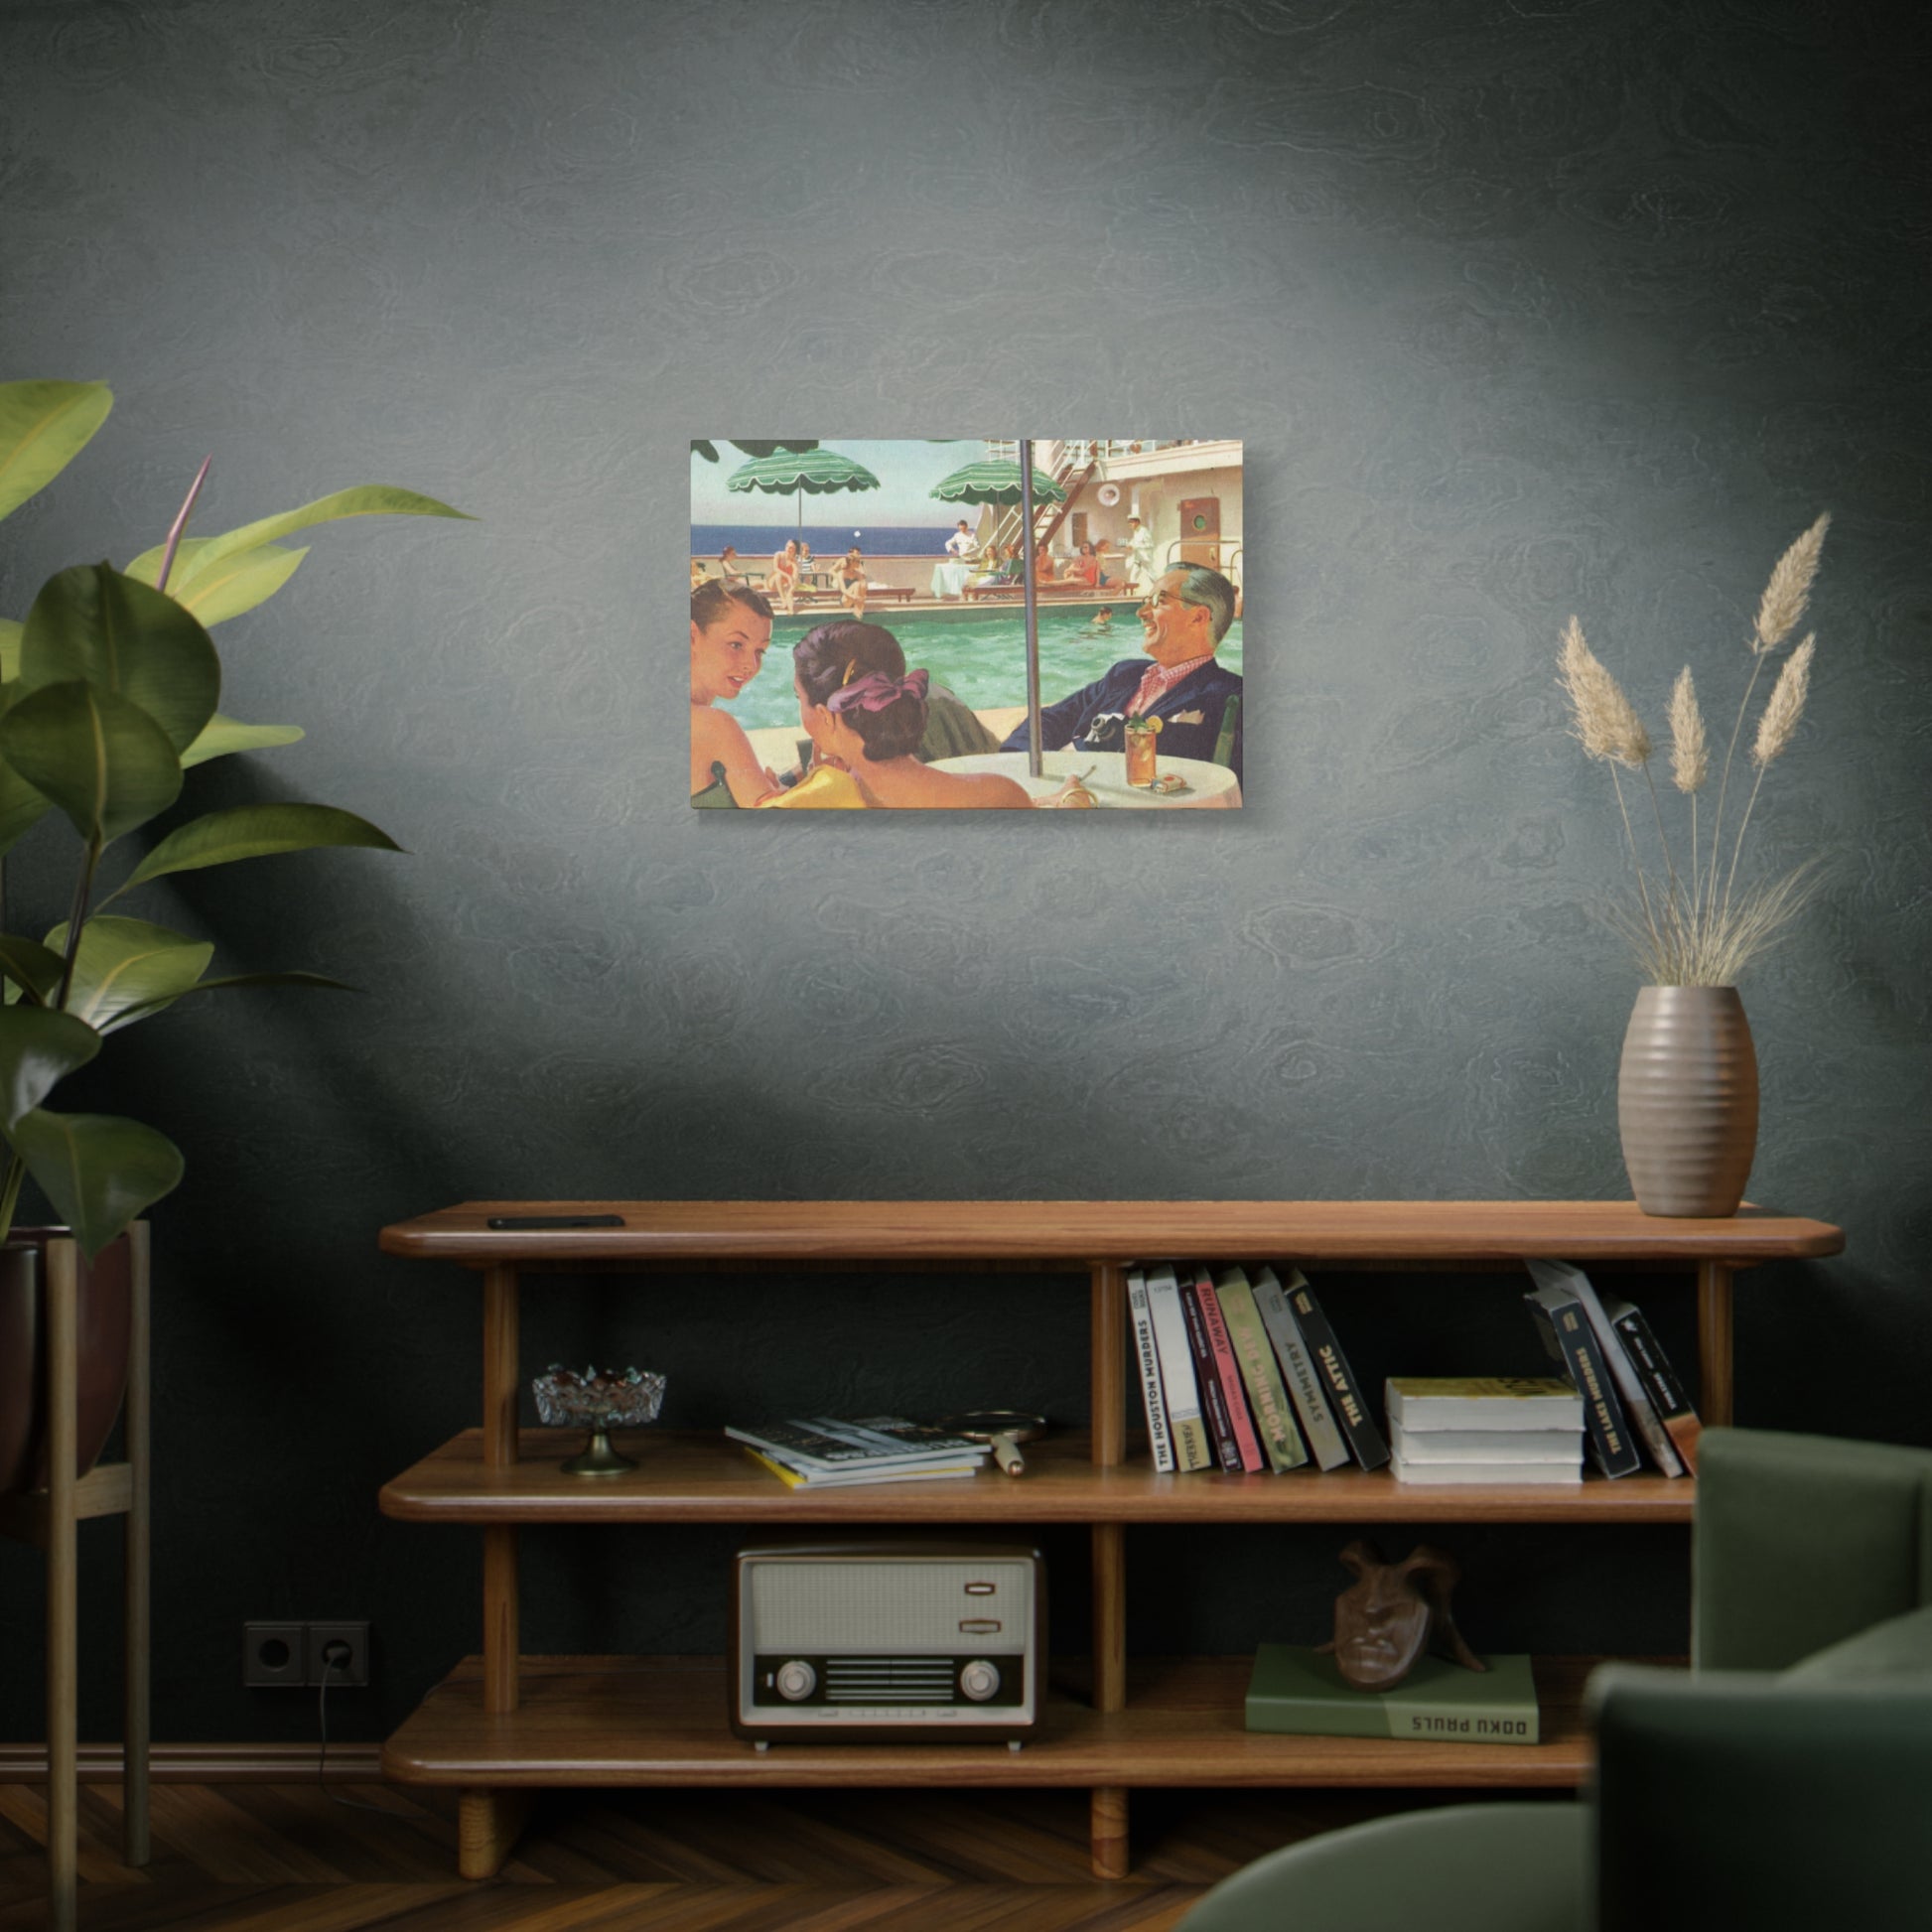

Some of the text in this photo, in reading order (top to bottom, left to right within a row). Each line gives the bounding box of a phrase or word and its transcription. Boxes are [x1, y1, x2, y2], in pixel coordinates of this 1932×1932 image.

[1201, 1287, 1229, 1354] RUNAWAY
[1138, 1319, 1169, 1466] THE HOUSTON MURDERS
[1249, 1361, 1286, 1442] MORNING
[1284, 1341, 1323, 1423] SYMMETRY
[1318, 1344, 1363, 1427] THE ATTIC
[1575, 1346, 1622, 1455] THE LAKE MURDERS
[1477, 1719, 1527, 1735] DOKU
